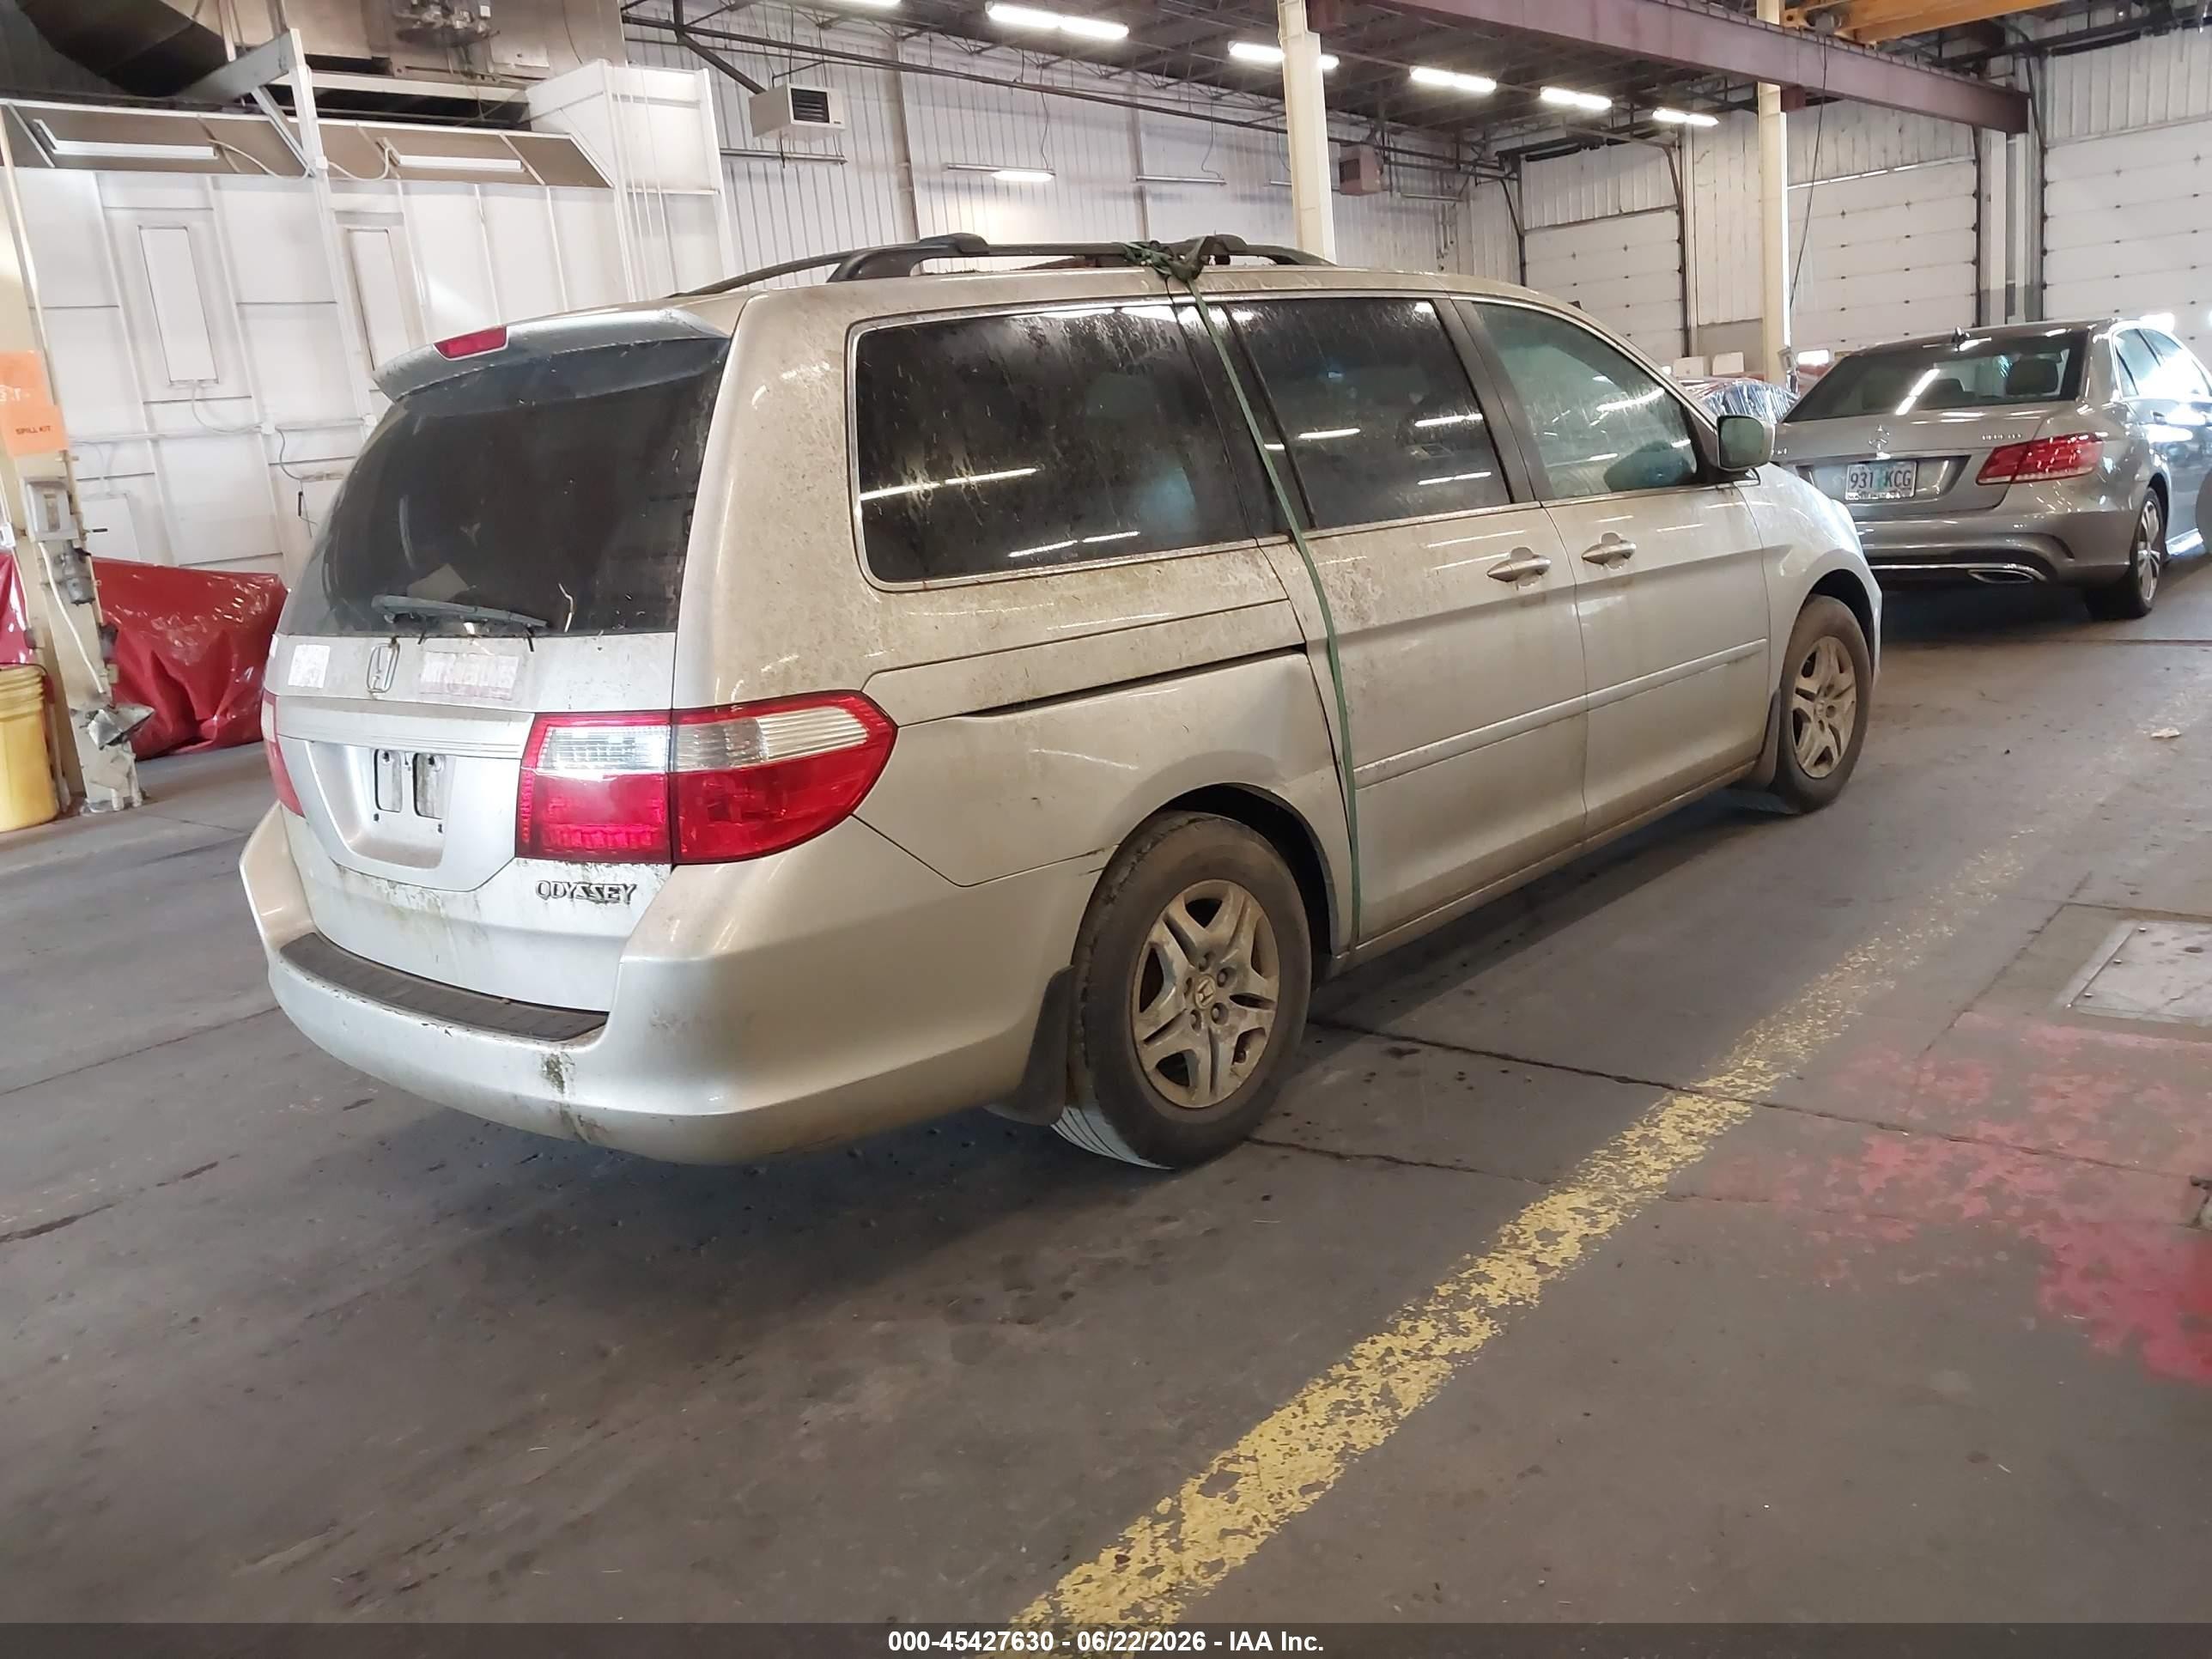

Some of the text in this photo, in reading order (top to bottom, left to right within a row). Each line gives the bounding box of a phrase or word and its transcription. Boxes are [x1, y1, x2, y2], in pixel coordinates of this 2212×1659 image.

[1850, 470, 1911, 489] 931 KCG
[535, 879, 637, 905] ODYSSEY
